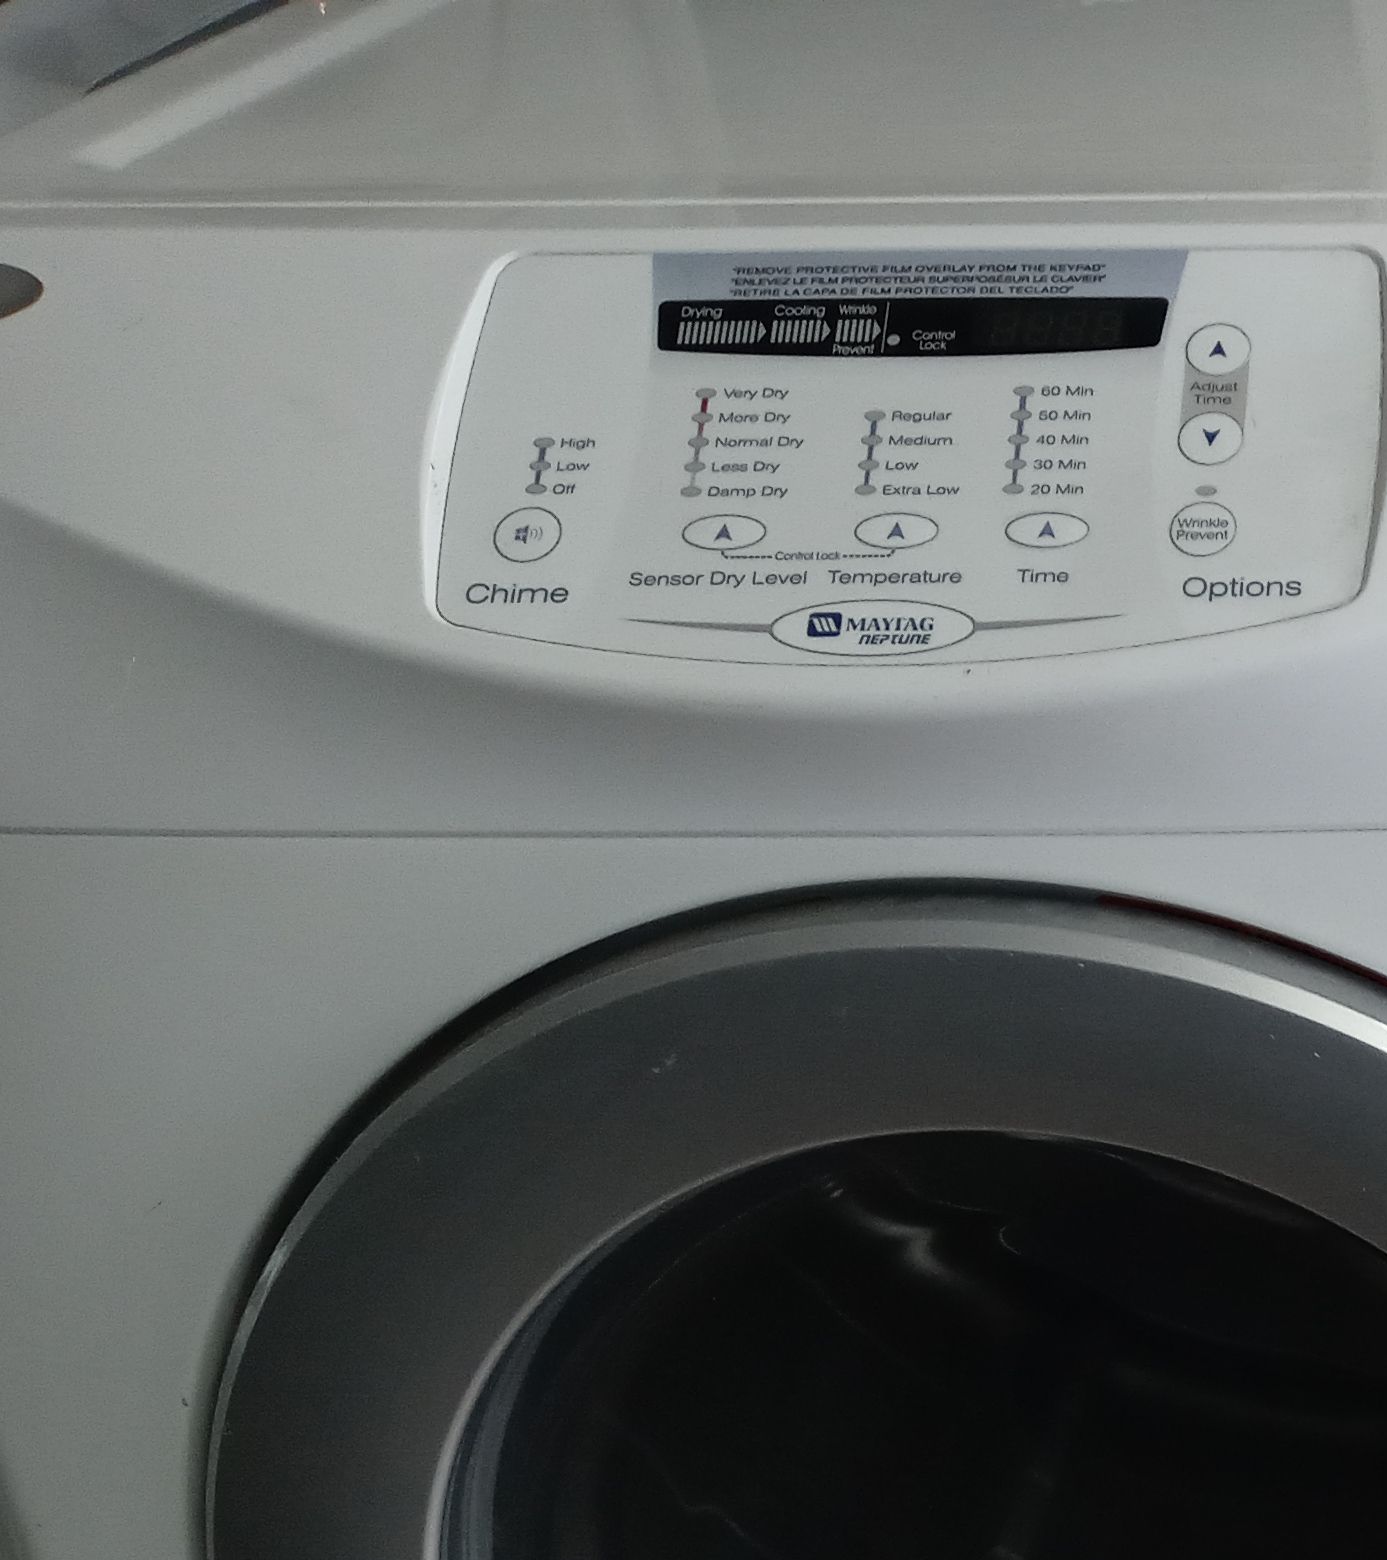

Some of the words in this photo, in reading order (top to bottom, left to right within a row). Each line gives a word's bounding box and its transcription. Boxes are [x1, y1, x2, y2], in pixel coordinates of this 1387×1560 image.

[882, 265, 912, 273] FILM
[915, 265, 975, 273] OVERLAY
[979, 264, 1017, 272] FROM
[1021, 264, 1046, 272] THE
[803, 288, 837, 296] CAPA
[862, 287, 891, 295] FILM
[980, 286, 1004, 294] DEL
[681, 305, 722, 319] Drying
[774, 304, 826, 318] Cooling
[839, 304, 877, 316] Wrinkle
[912, 330, 956, 341] Control
[832, 344, 875, 355] Prevent
[919, 340, 948, 351] Lock
[723, 387, 755, 400] Very
[761, 387, 790, 400] Dry
[1041, 386, 1060, 396] 60
[1064, 386, 1094, 396] Min
[1190, 381, 1238, 394] Adjust
[1194, 394, 1232, 405] Time
[719, 411, 757, 423] More
[765, 411, 792, 425] Dry
[891, 409, 952, 423] Regular
[1062, 410, 1091, 421] Min
[560, 437, 595, 450] High
[715, 436, 773, 448] Normal
[777, 436, 805, 450] Dry
[888, 435, 953, 447] Medium
[1036, 434, 1055, 445] 40
[1059, 434, 1089, 445] Min
[557, 461, 589, 471] Low
[711, 460, 748, 472] Less
[752, 460, 781, 473] Dry
[885, 460, 918, 470] Low
[1033, 459, 1053, 469] 30
[1057, 459, 1087, 469] Min
[553, 483, 575, 495] Off
[708, 485, 754, 499] Damp
[760, 485, 789, 498] Dry
[882, 483, 921, 496] Extra
[927, 484, 960, 496] Low
[1030, 484, 1050, 495] 20
[1054, 484, 1084, 495] Min
[1176, 518, 1228, 529] Wrinkle
[1176, 530, 1227, 541] Prevent
[629, 571, 704, 587] Sensor
[710, 571, 746, 588] Dry
[752, 570, 807, 586] Level
[828, 569, 962, 587] Temperature
[1017, 569, 1069, 583] Time
[466, 584, 569, 605] Chime
[1182, 577, 1302, 601] Options
[845, 617, 934, 632] MAYTAG
